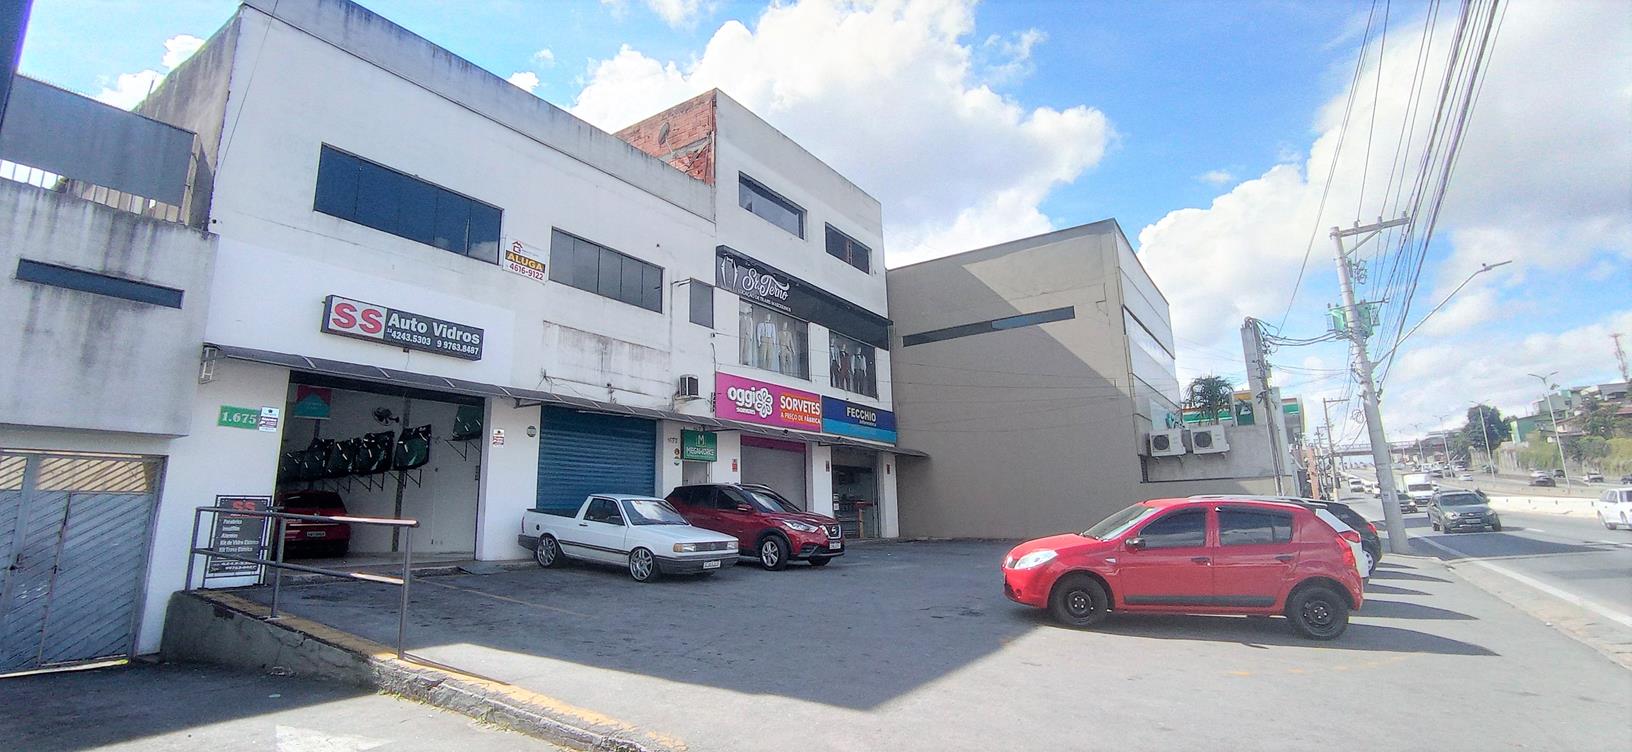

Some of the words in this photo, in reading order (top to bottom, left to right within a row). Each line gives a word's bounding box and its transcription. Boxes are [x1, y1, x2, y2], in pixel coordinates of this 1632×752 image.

[507, 253, 543, 271] ALUGA
[332, 302, 383, 334] SS
[388, 312, 428, 334] Auto
[432, 321, 480, 345] Vidros
[391, 330, 431, 346] 4243.5303
[437, 339, 442, 348] 9
[727, 386, 756, 408] oggi
[780, 395, 821, 416] SORVETES
[222, 411, 257, 425] 1.675
[846, 406, 877, 422] FECCHIO
